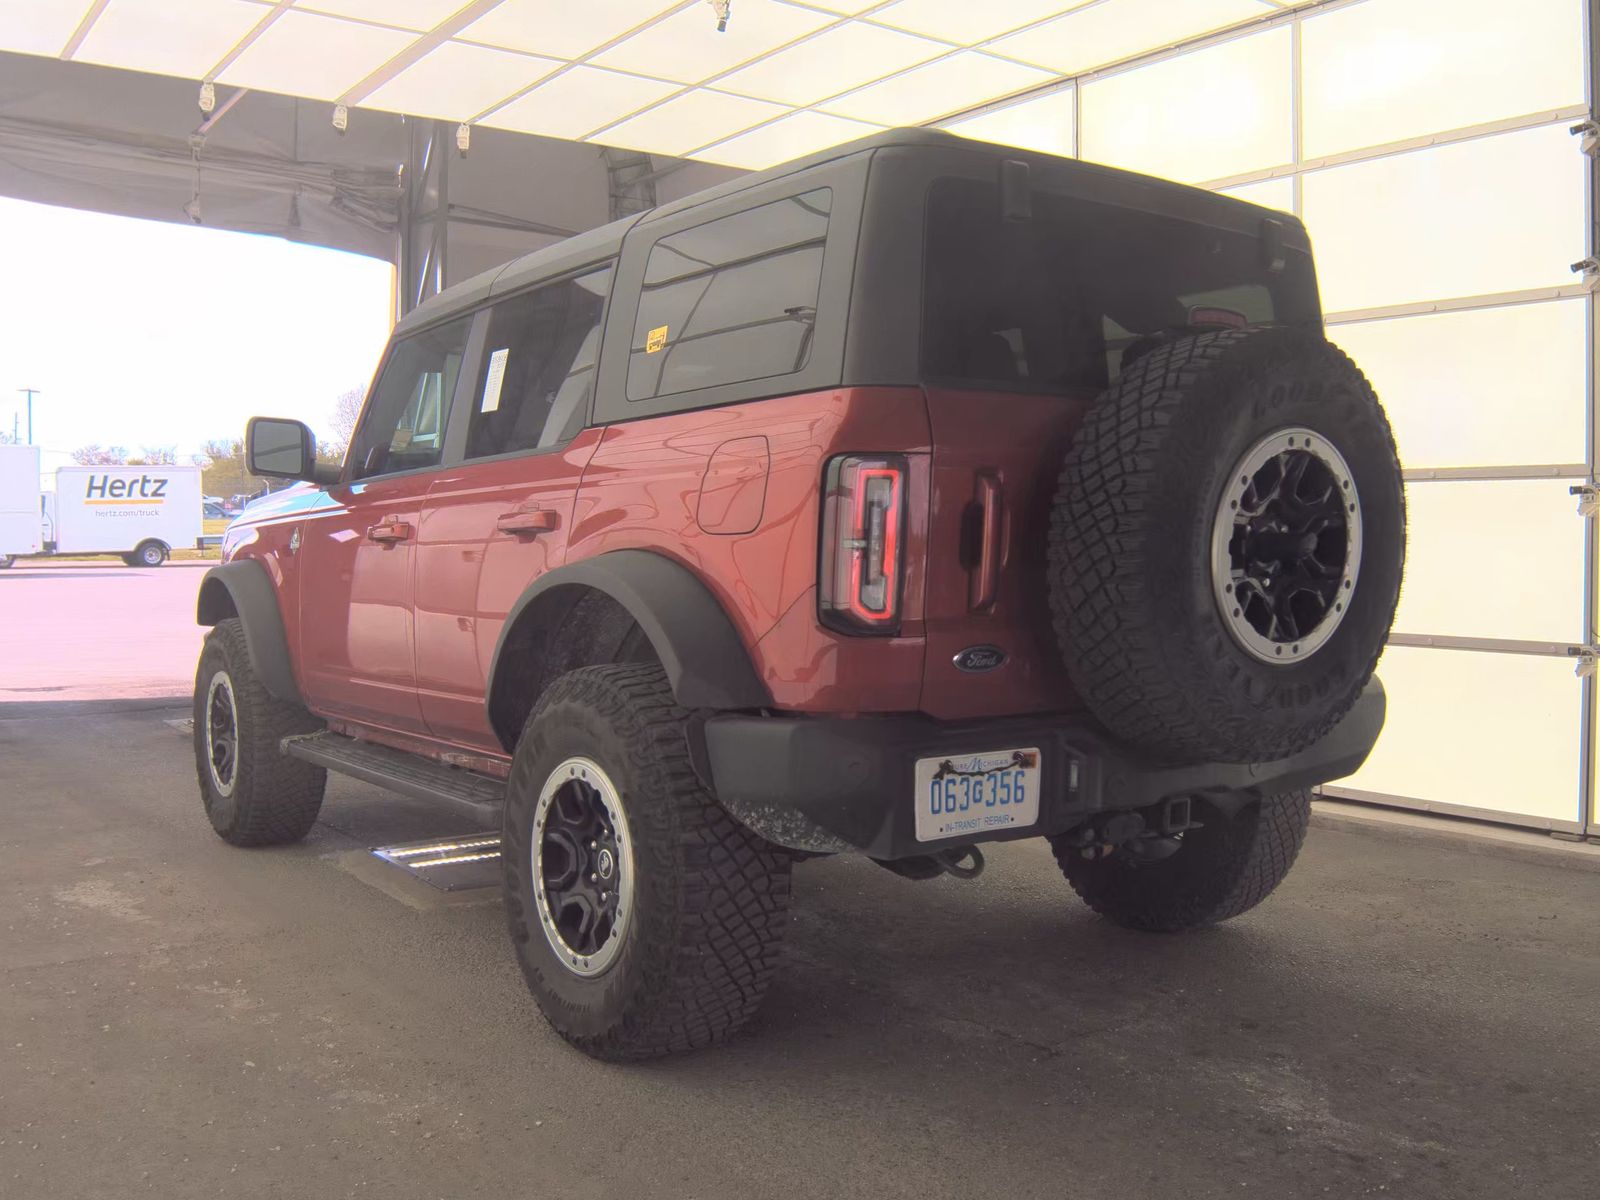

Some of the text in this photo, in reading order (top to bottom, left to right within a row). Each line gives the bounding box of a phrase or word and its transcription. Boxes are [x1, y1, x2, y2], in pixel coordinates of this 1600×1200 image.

[86, 475, 168, 498] Hertz
[95, 508, 160, 518] hertz.com/truck
[930, 770, 1026, 815] 063G356
[945, 814, 1010, 833] IN-TRANSIT REPAIR
